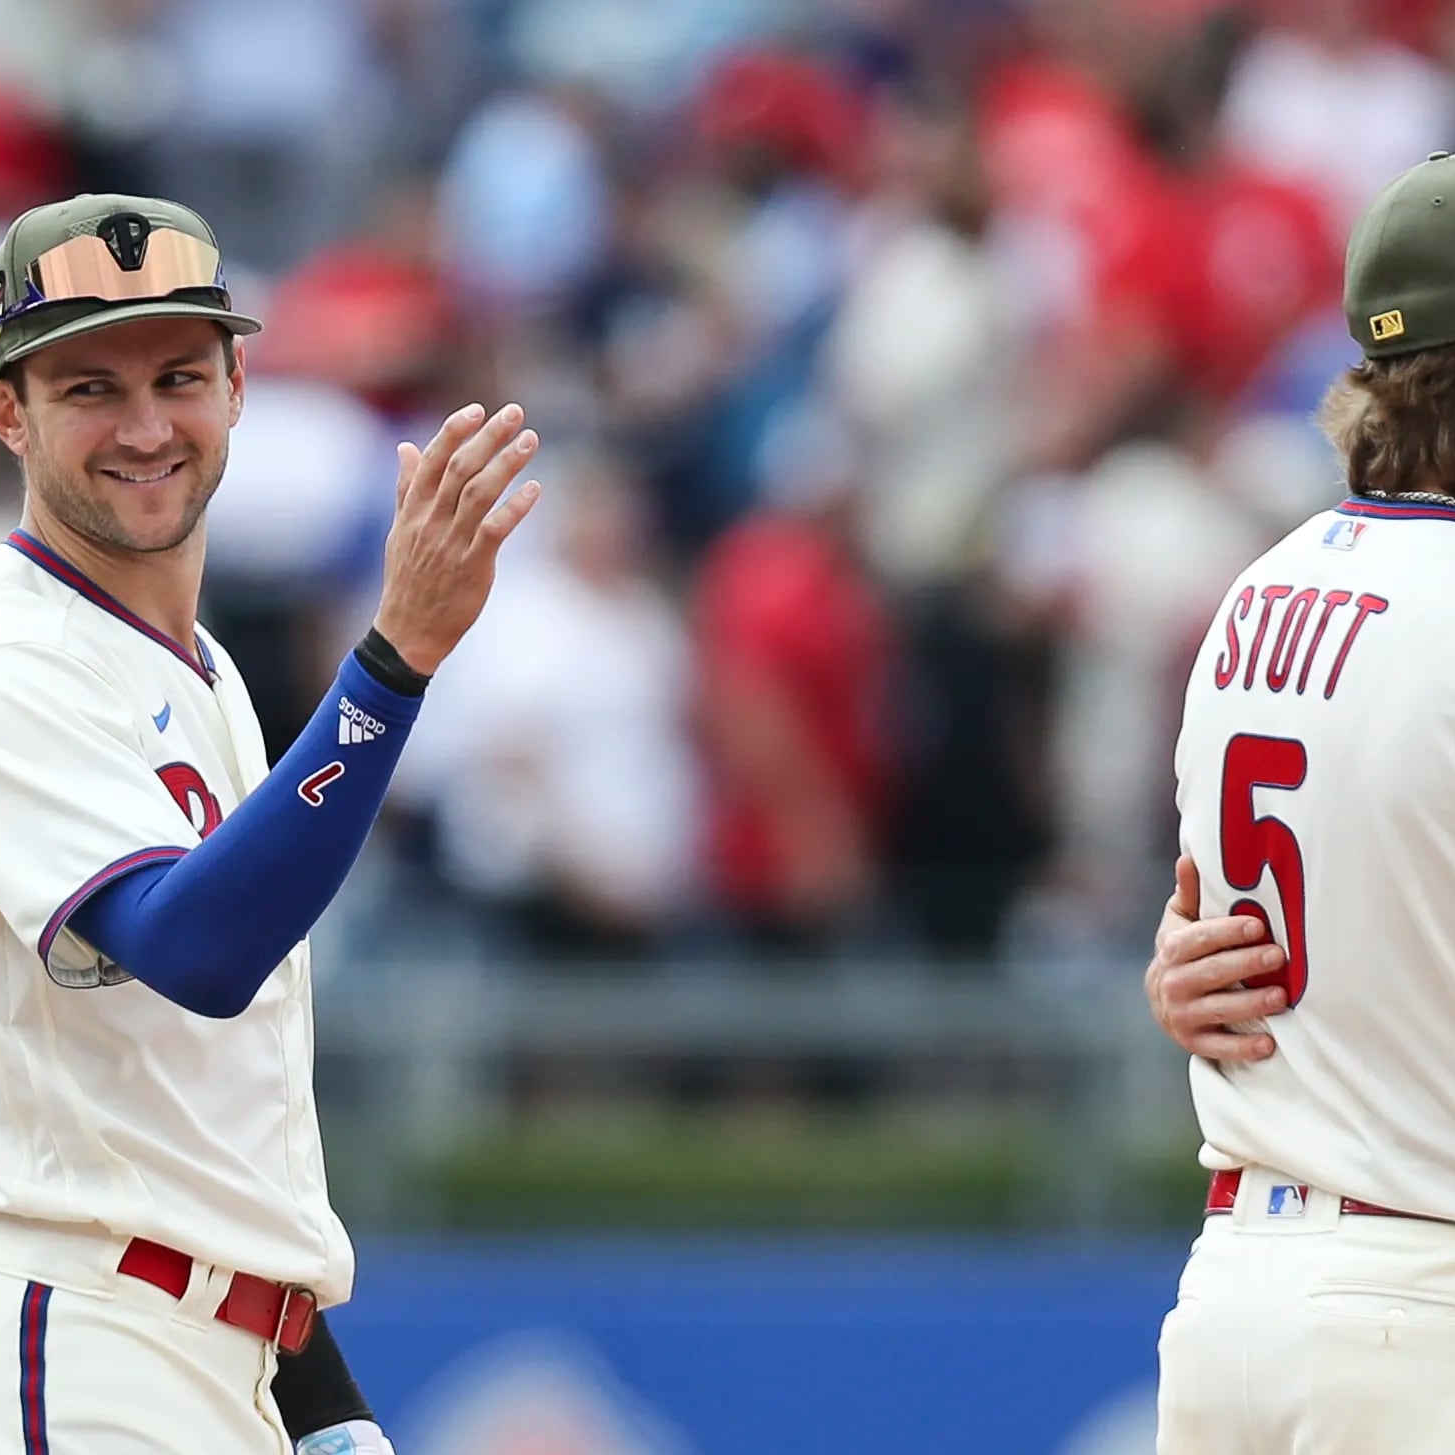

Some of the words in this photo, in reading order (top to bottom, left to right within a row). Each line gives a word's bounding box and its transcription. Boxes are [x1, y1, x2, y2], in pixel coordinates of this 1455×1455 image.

[1215, 583, 1390, 701] STOTT
[338, 696, 386, 735] adidas
[1219, 732, 1309, 1010] 5
